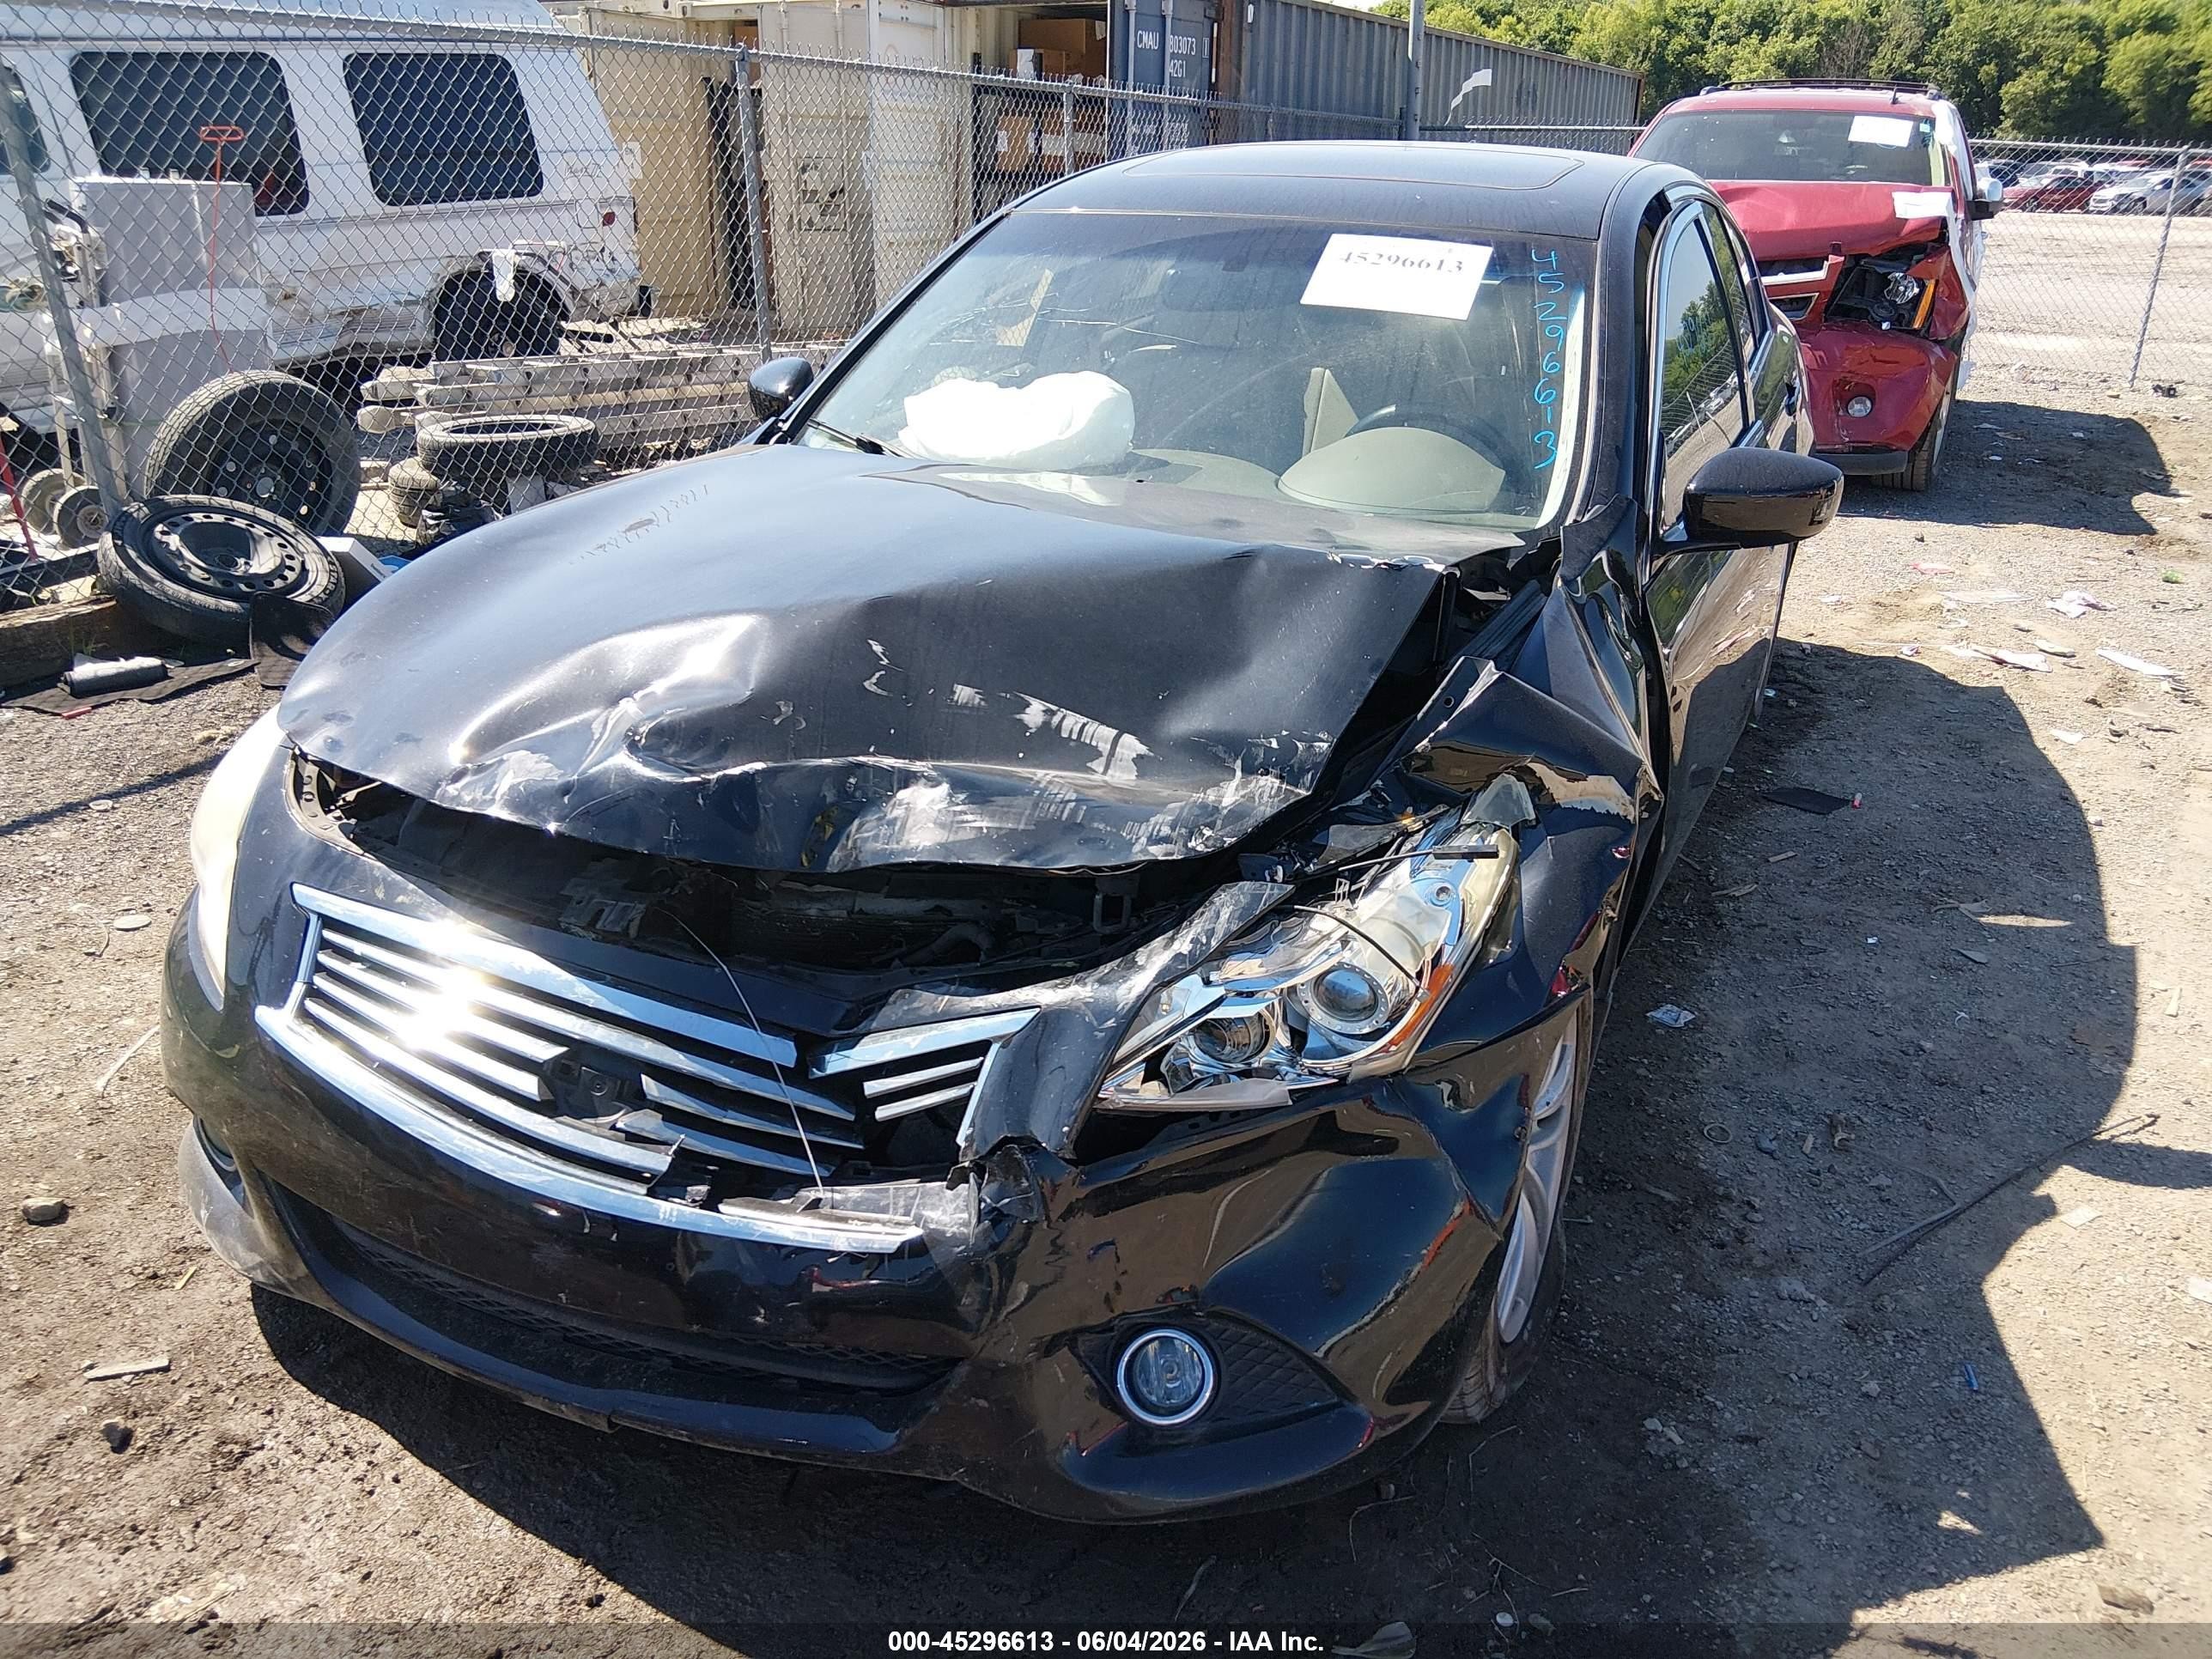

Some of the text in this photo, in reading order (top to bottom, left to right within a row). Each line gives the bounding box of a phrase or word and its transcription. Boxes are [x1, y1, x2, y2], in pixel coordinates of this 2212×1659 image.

[1136, 30, 1159, 50] CMAU
[1169, 34, 1196, 56] 803073
[1340, 251, 1463, 273] 45296613
[1532, 248, 1568, 470] 45296613
